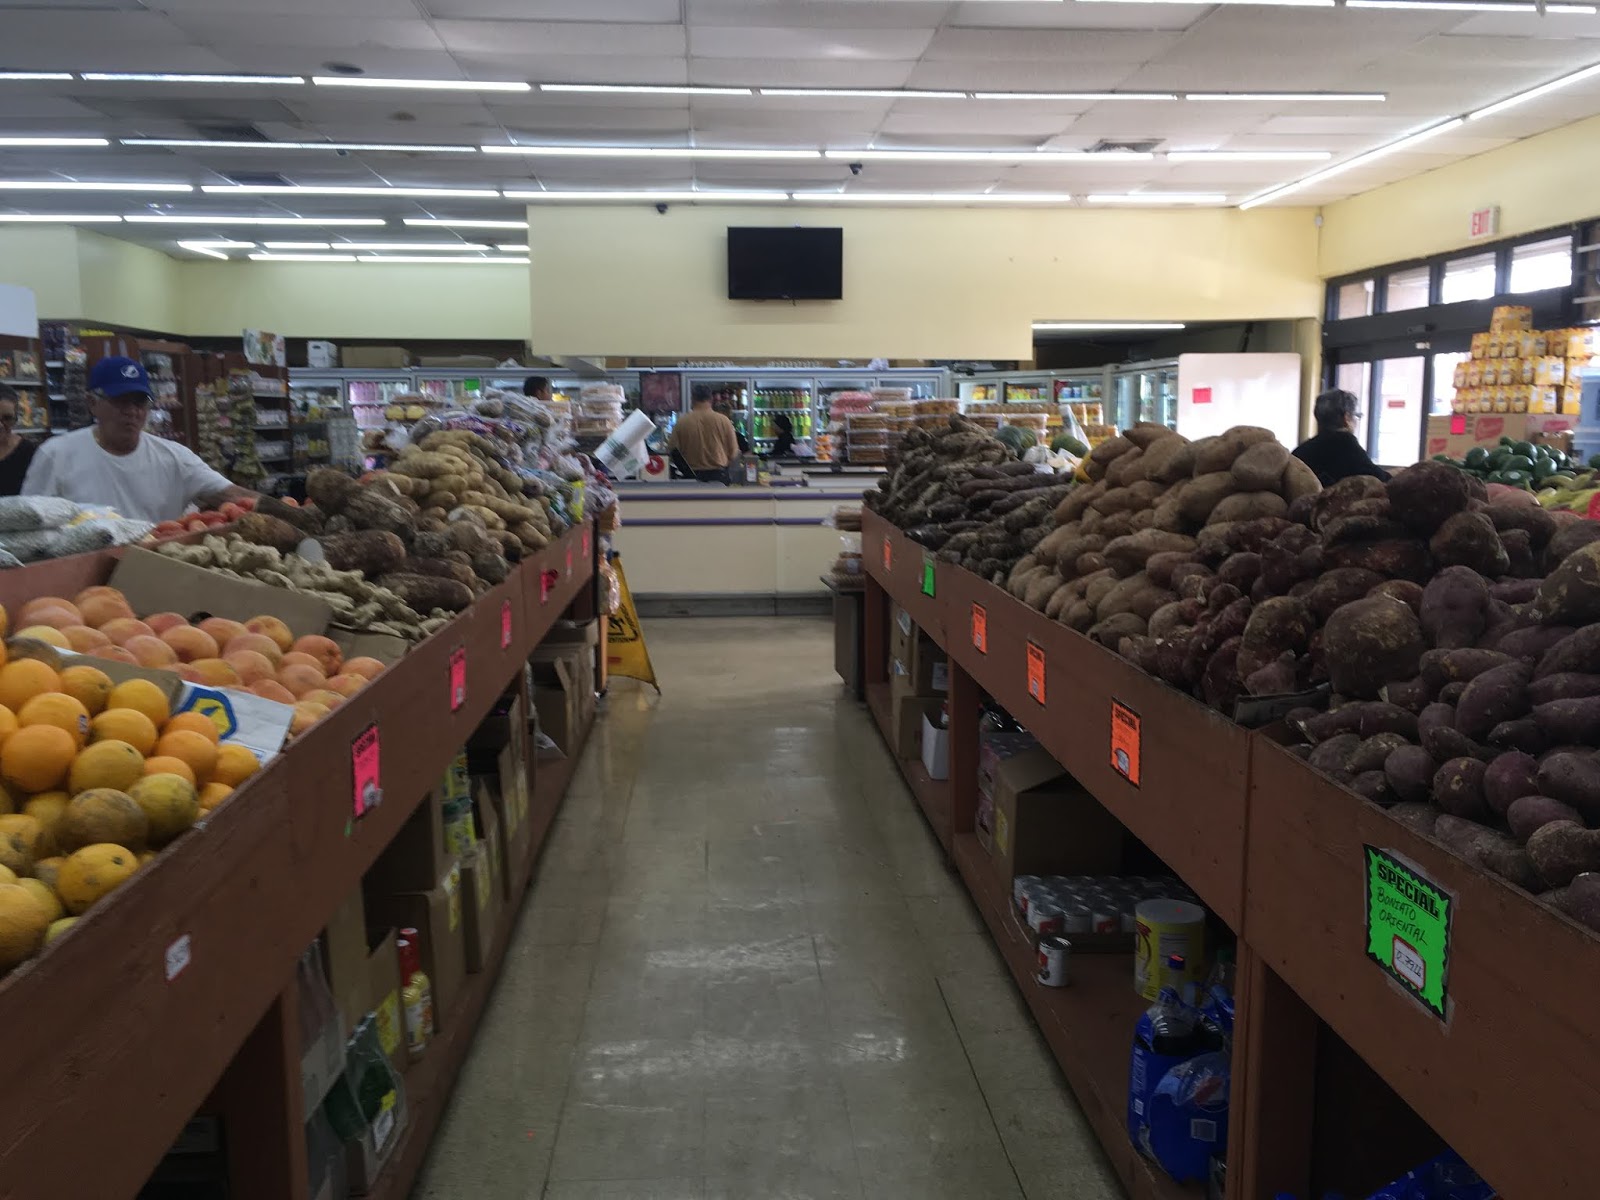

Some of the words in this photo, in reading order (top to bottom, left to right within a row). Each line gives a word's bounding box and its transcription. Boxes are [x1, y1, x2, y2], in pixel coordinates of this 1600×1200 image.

[1377, 861, 1440, 919] SPECIAL
[1377, 887, 1416, 921] BONIATO
[1379, 909, 1428, 946] ORIENTAL
